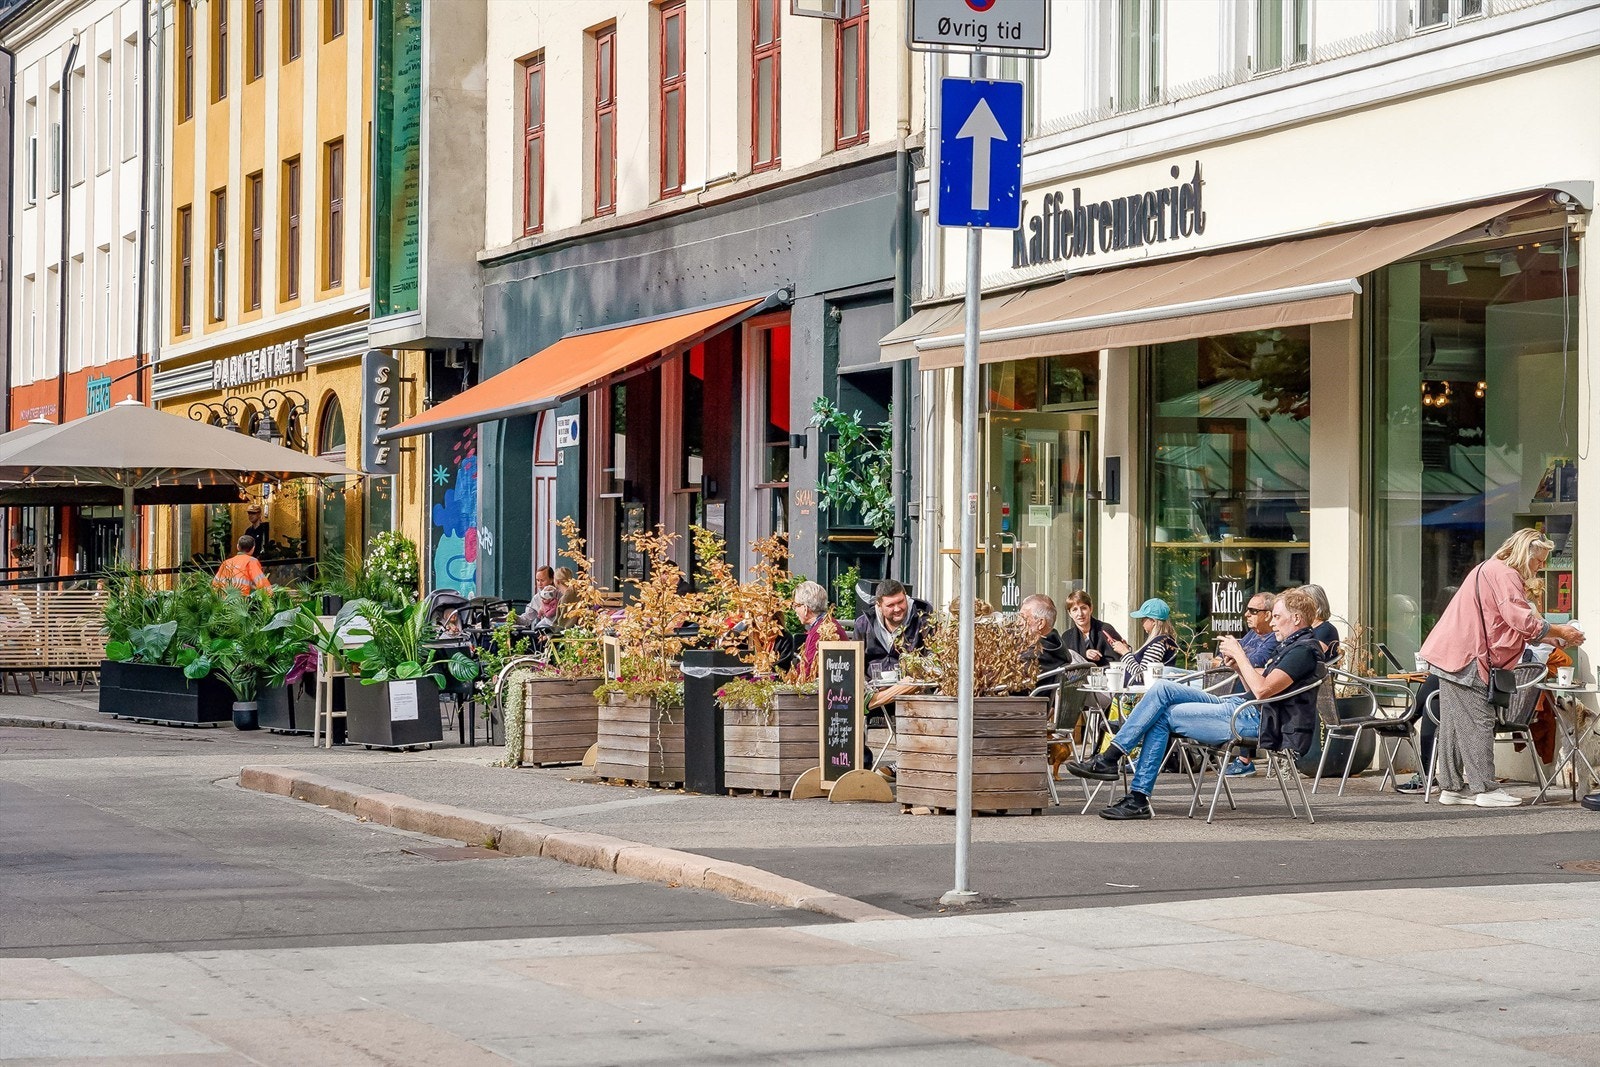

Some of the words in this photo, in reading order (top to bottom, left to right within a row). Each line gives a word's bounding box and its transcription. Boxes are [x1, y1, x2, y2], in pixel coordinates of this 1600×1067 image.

[938, 17, 988, 42] Øvrig
[997, 21, 1022, 40] tid
[1012, 160, 1206, 269] Kaffebrenneriet
[213, 338, 300, 390] PARKTEATRET
[1002, 577, 1020, 607] affe
[1211, 581, 1243, 614] Kaffe
[1211, 615, 1243, 632] brenneriet
